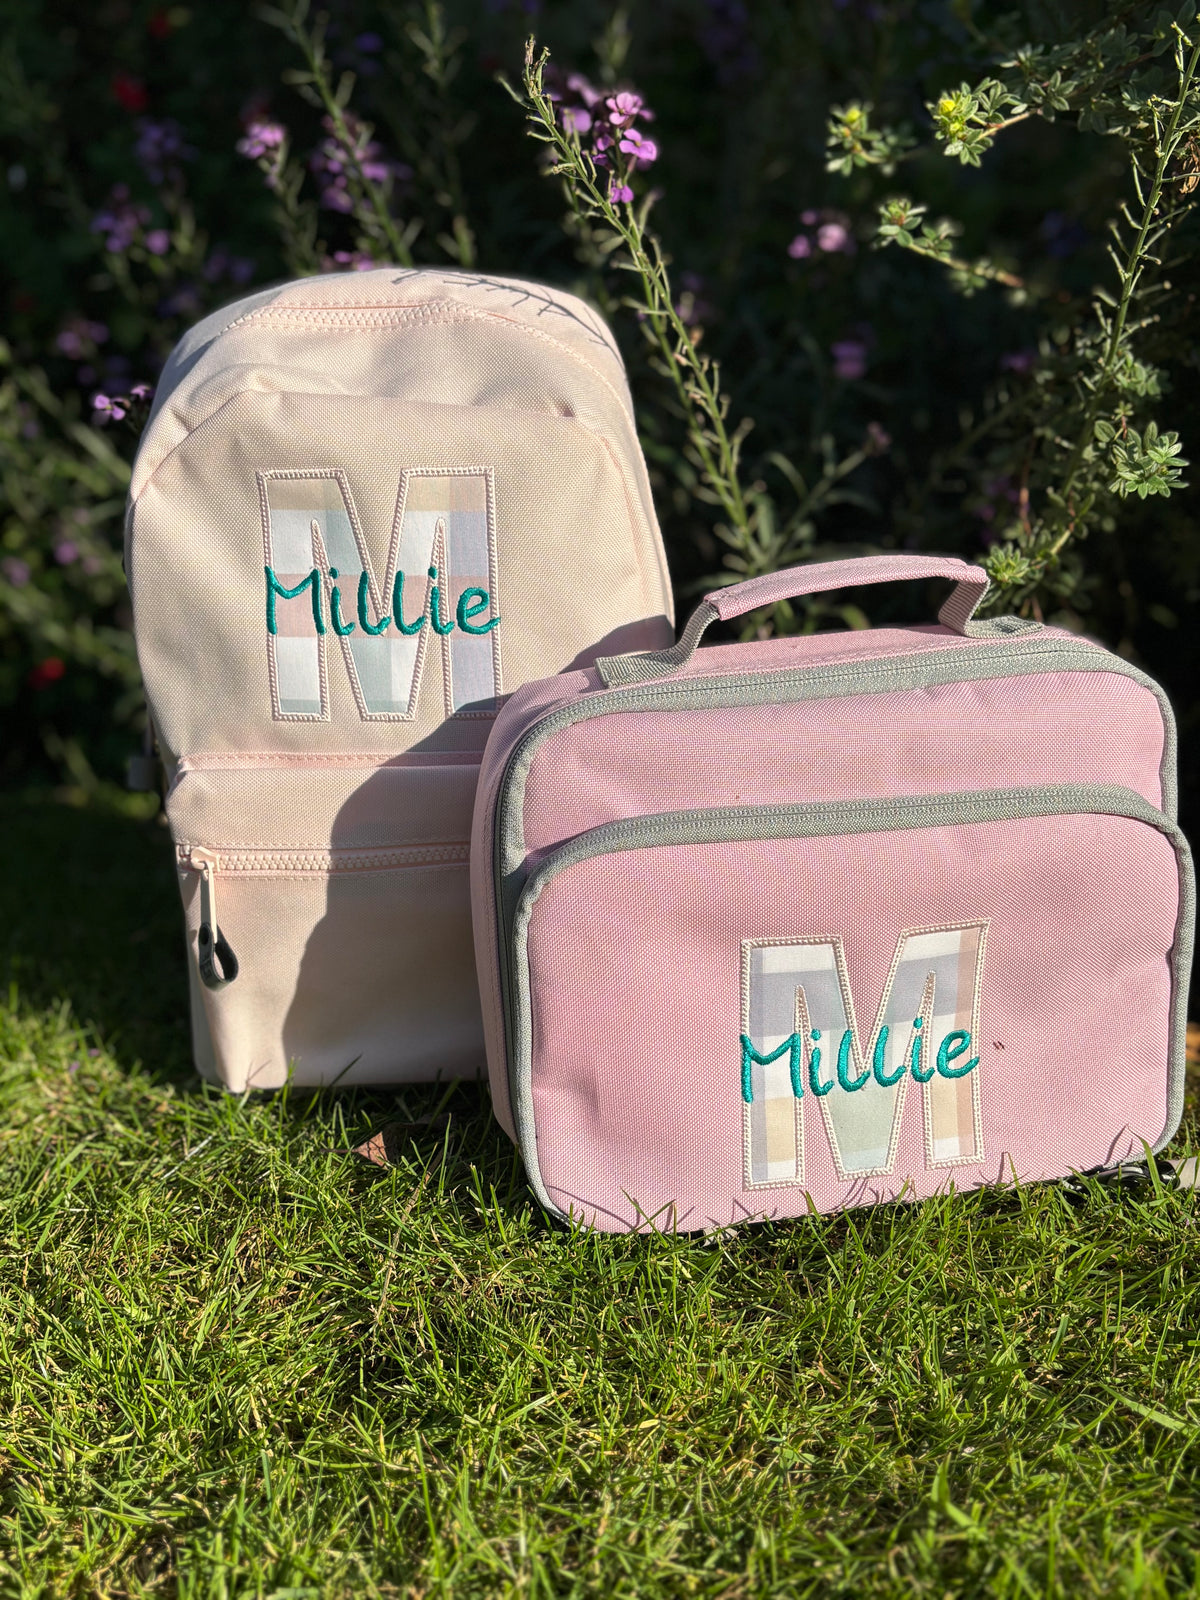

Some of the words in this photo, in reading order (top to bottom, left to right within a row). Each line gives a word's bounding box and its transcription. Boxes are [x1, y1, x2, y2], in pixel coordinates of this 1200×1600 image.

[256, 466, 502, 722] M
[264, 566, 501, 636] Millie
[739, 1016, 980, 1104] Millie
[740, 917, 991, 1192] M
